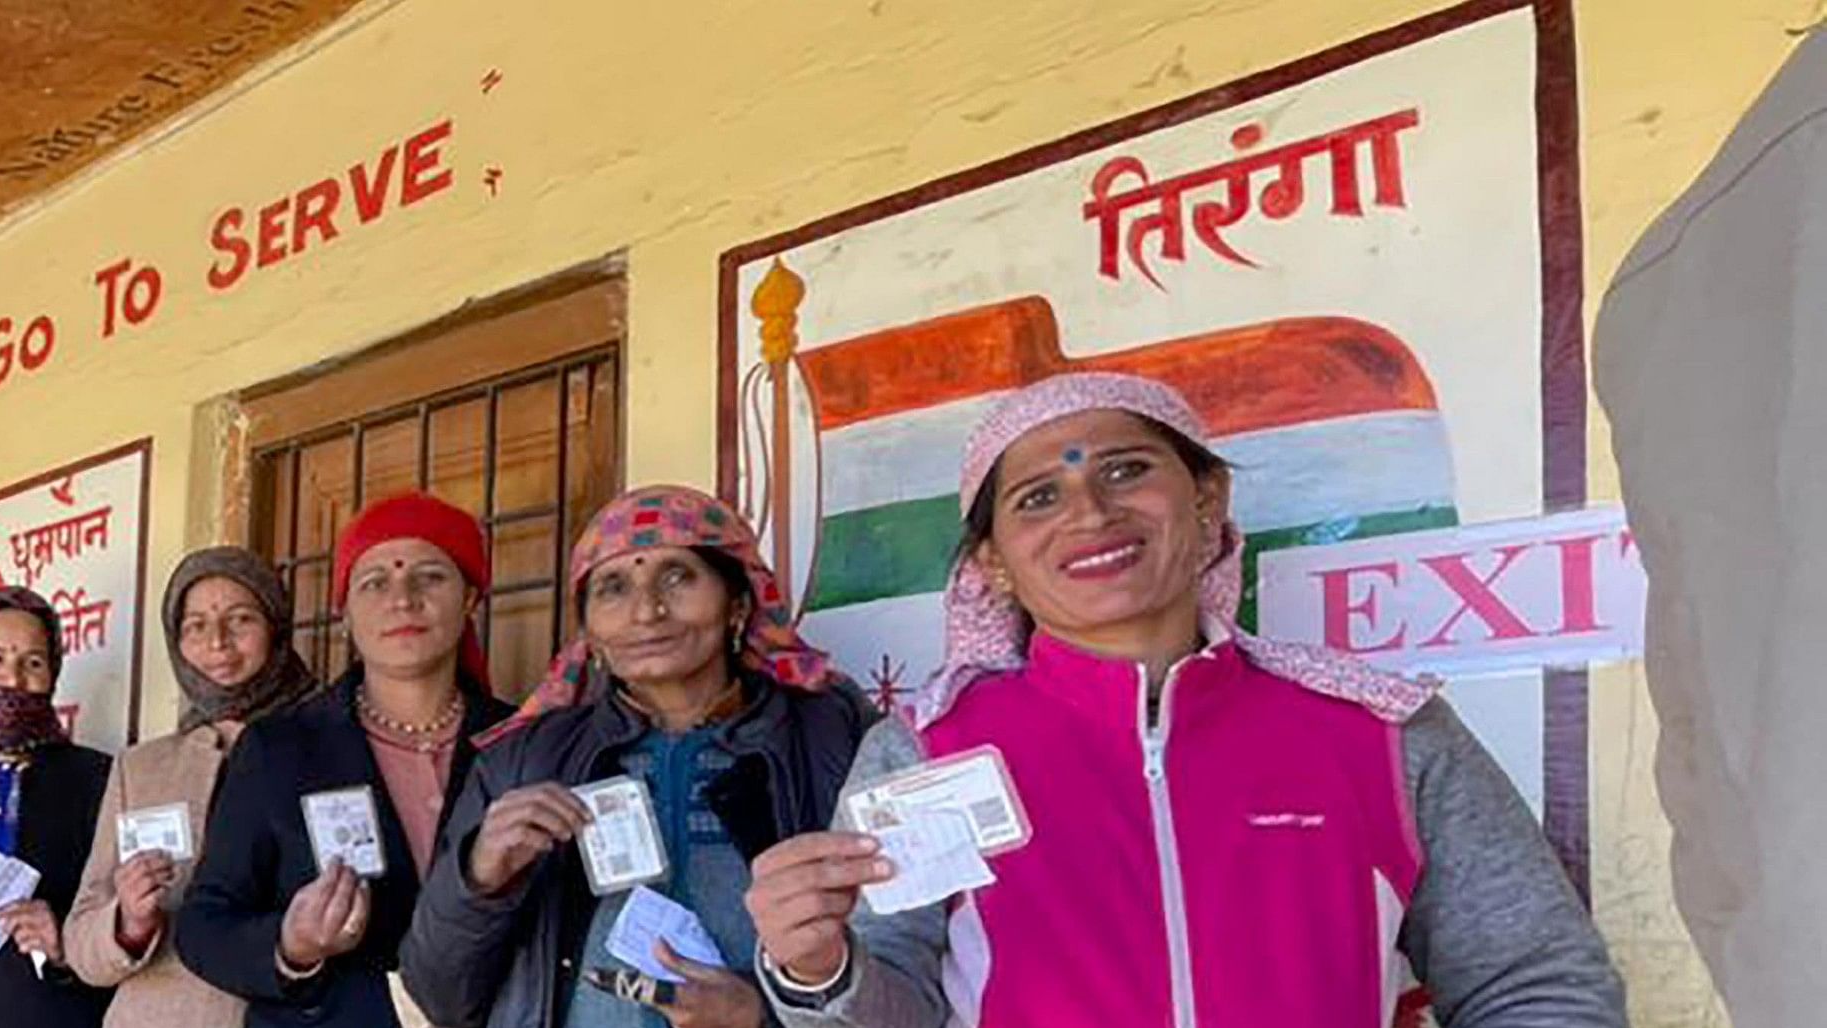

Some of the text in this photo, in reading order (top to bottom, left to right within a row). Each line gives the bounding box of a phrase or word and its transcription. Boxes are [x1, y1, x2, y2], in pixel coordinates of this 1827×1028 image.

[208, 119, 454, 290] SERVE
[1082, 107, 1420, 294] तिरंगा
[1307, 529, 1637, 656] EXI
